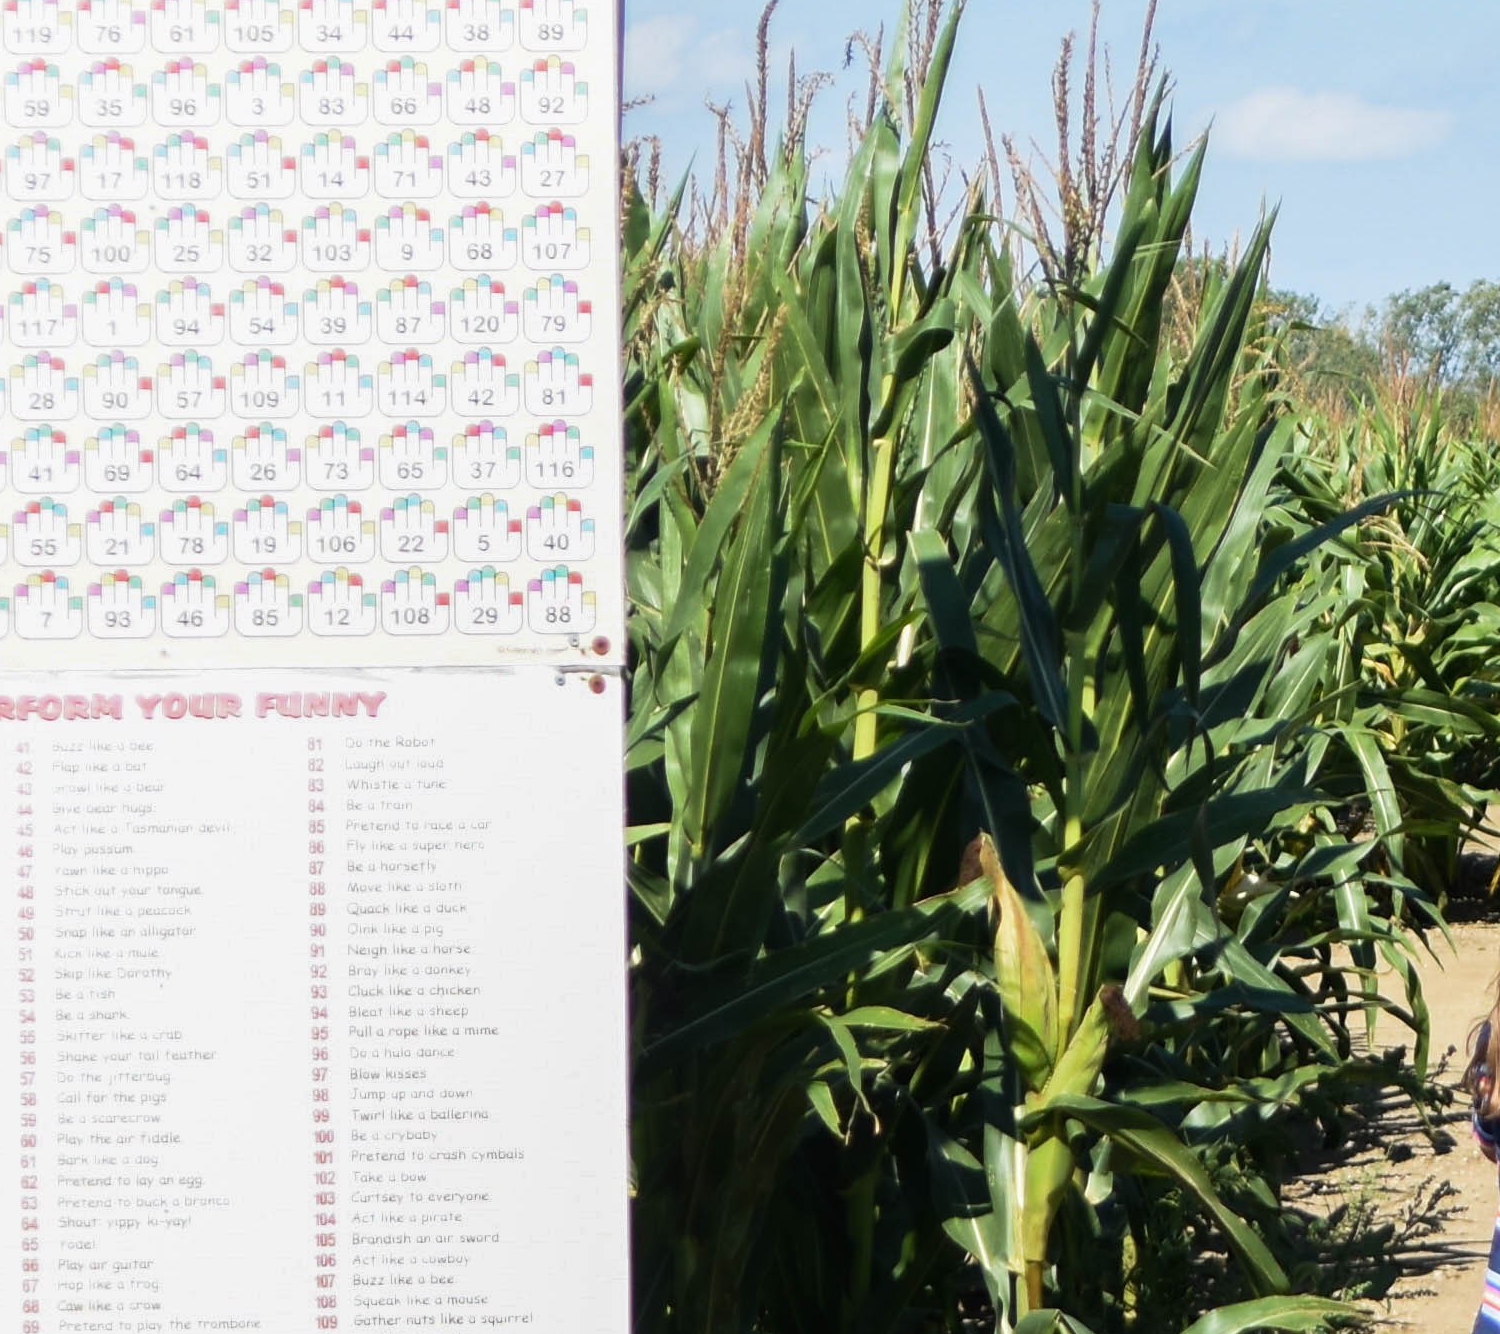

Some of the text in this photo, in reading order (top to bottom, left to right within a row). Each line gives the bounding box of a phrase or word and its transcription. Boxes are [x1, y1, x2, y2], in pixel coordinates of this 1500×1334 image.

[25, 173, 51, 190] 97
[98, 172, 122, 189] 17
[163, 172, 201, 189] 118
[247, 171, 270, 189] 51
[319, 171, 344, 187] 14
[393, 171, 415, 187] 71
[465, 170, 492, 187] 43
[540, 170, 565, 187] 27
[29, 393, 55, 410] 28
[102, 392, 128, 409] 90
[177, 391, 202, 409] 57
[240, 391, 279, 408] 109
[322, 390, 344, 406] 11
[388, 390, 428, 405] 114
[468, 389, 493, 406] 42
[542, 387, 565, 405] 81
[41, 611, 52, 627] 7
[105, 611, 131, 627] 93
[176, 610, 203, 627] 46
[252, 609, 278, 627] 85
[324, 608, 350, 625] 12
[391, 608, 430, 624] 108
[473, 607, 498, 624] 29
[546, 606, 571, 623] 88
[136, 692, 242, 720] YOUR
[256, 690, 388, 719] FUNNY
[311, 985, 481, 999] 93 Cluck like a chicken
[311, 1025, 498, 1041] 95 Pull a rope like a mime
[313, 1109, 330, 1123] 99
[418, 1112, 426, 1120] a
[314, 1148, 524, 1164] 101 Pretend to crash cymbals
[352, 1233, 411, 1245] Brandish
[416, 1235, 430, 1244] an
[435, 1234, 453, 1244] air
[460, 1233, 499, 1243] sword
[22, 1258, 39, 1272] 66
